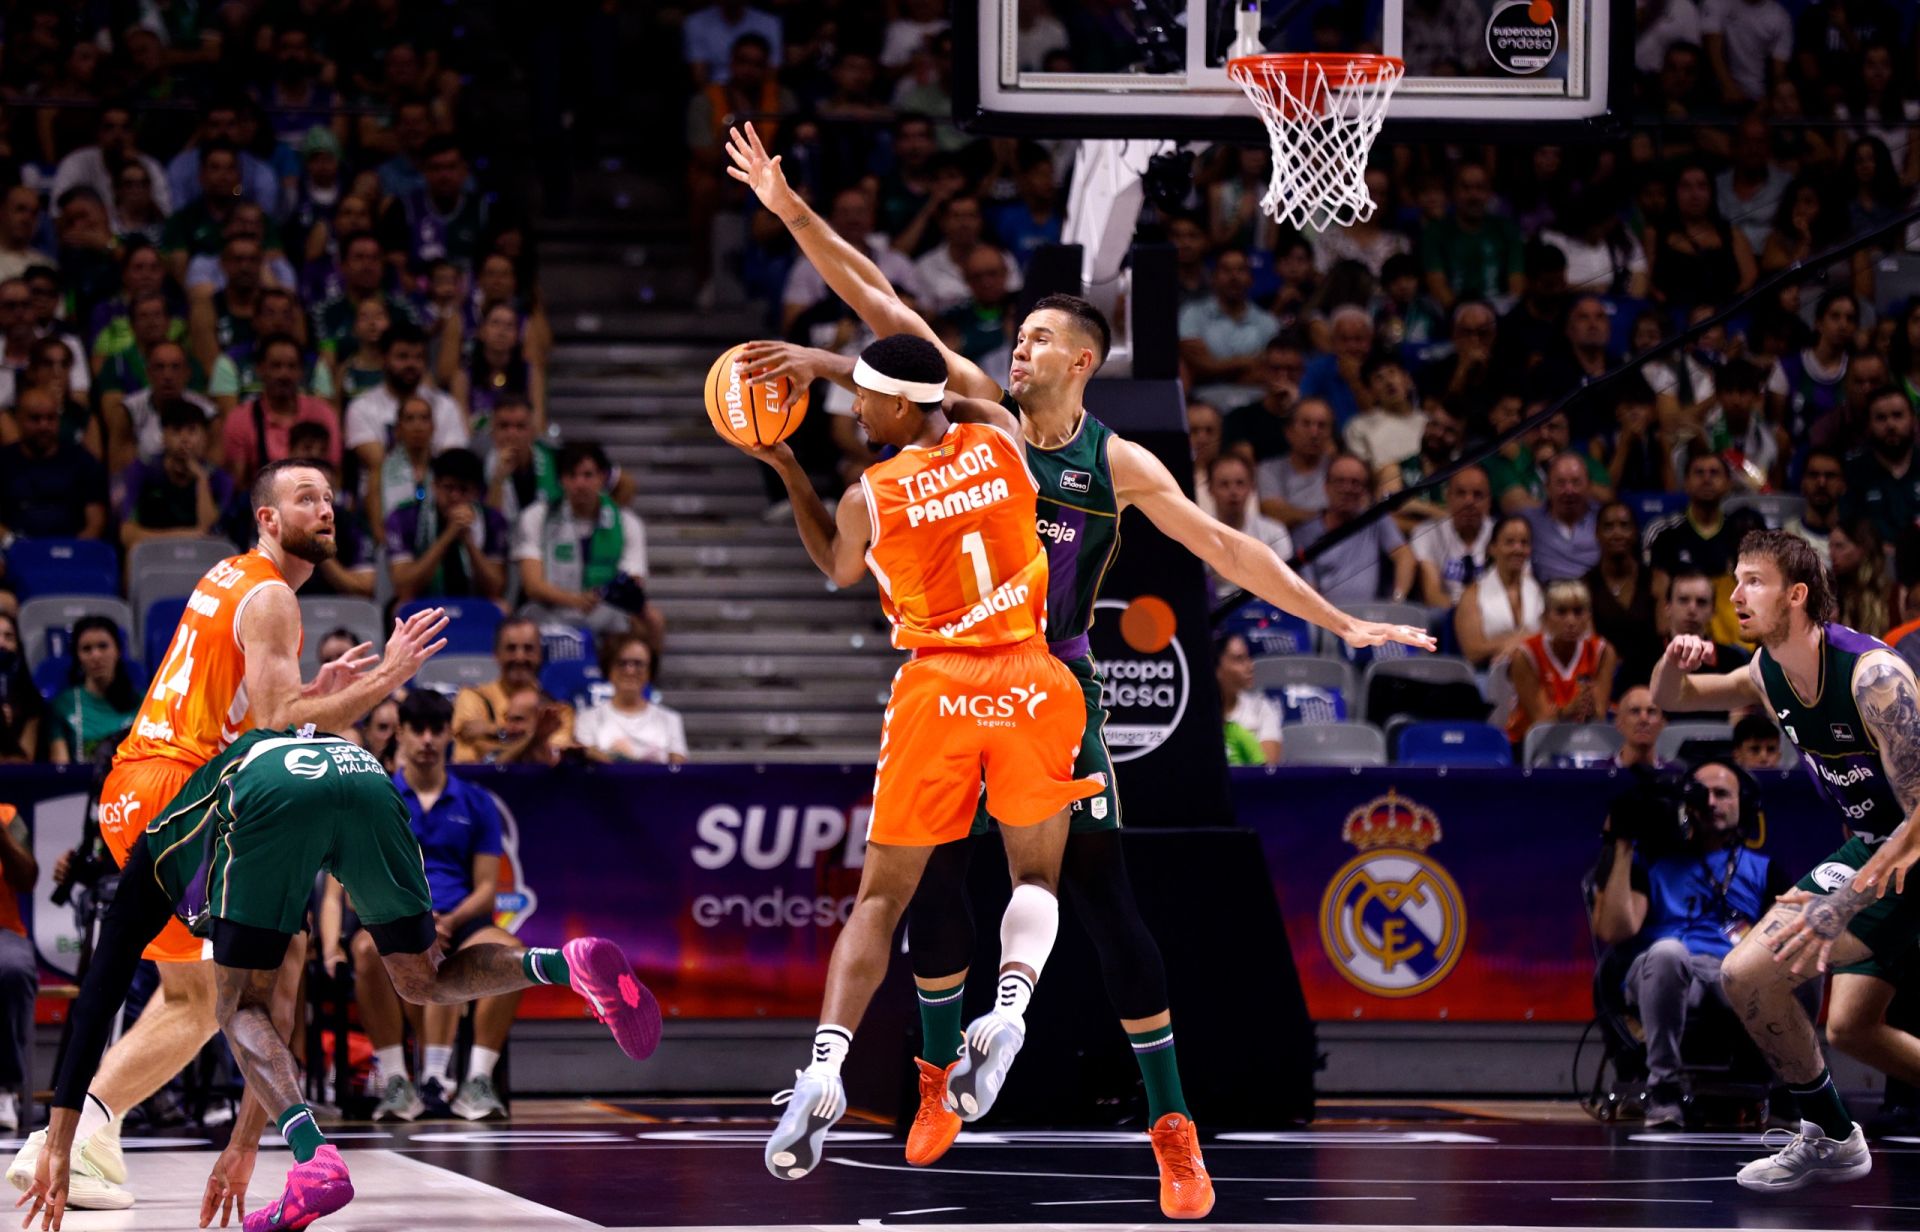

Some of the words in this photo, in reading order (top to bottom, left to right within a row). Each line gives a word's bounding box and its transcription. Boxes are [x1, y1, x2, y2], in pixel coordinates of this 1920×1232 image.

[1493, 27, 1552, 40] supercopa
[1498, 37, 1552, 50] endesa
[897, 443, 999, 504] TAYLOR
[906, 477, 1009, 528] PAMESA
[1036, 519, 1076, 544] caja
[961, 530, 994, 601] 1
[1096, 660, 1175, 683] rcopa
[1101, 680, 1175, 708] desa
[939, 695, 1015, 718] MGS
[976, 718, 1016, 728] Seguros
[332, 753, 360, 764] DEL
[337, 760, 387, 777] MÁLAGA
[1819, 764, 1874, 787] Unicaja
[690, 803, 875, 870] SUPE
